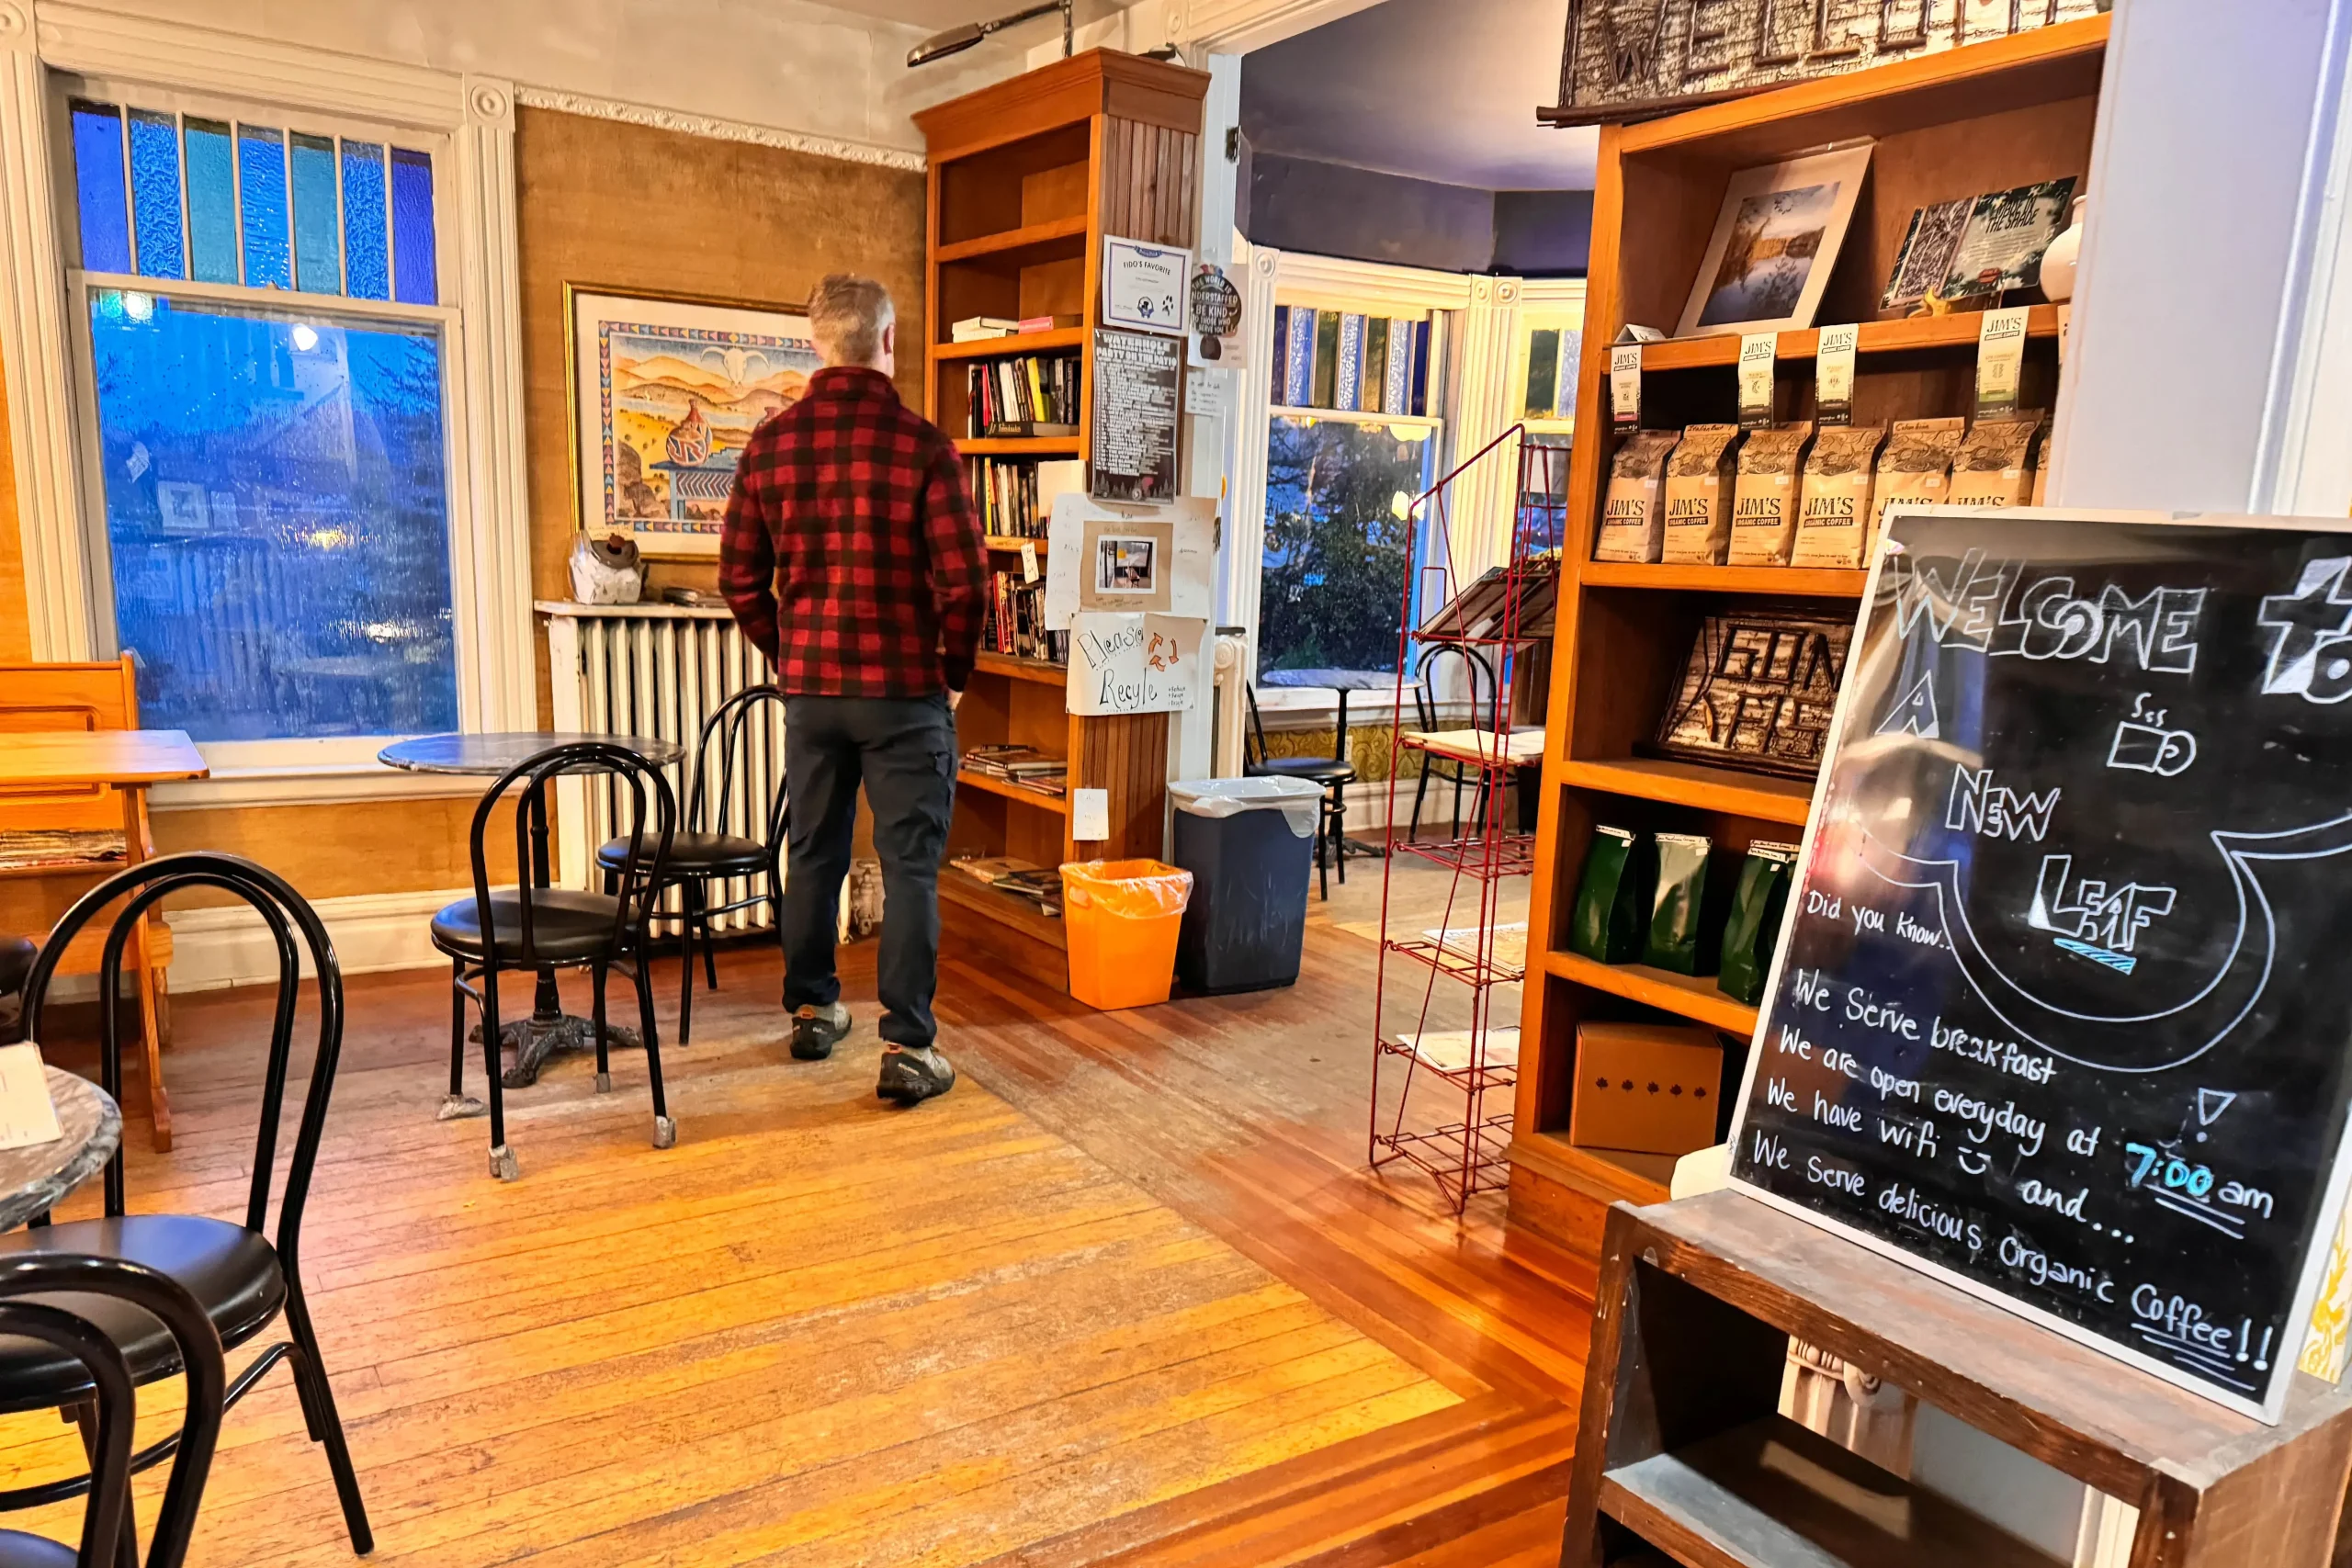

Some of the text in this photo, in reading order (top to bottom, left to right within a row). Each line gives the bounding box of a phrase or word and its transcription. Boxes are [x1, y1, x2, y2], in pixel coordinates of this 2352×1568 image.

[1985, 208, 2040, 233] THE SHADE
[1144, 262, 1170, 276] FAVORITE
[1191, 276, 1232, 294] THE WORLD IS
[1191, 291, 1238, 304] NDERSTAFFED
[1195, 304, 1227, 318] BE KIND
[1986, 317, 2022, 333] JIM'S
[1102, 333, 1170, 352] WATERHOLE
[1746, 341, 1771, 355] JIM'S
[1823, 332, 1852, 346] JIM'S
[1096, 347, 1177, 367] PARTY ON THE PATIO
[1614, 353, 1637, 365] JIM'S
[1607, 499, 1645, 515] JIM'S
[1669, 498, 1708, 515] JIM'S
[1736, 497, 1781, 515] JIM'S
[1804, 497, 1854, 516] JIM'S
[1805, 519, 1826, 527] ORGANIC
[1894, 547, 2206, 672] WELCOME
[1077, 626, 1144, 670] Please
[1100, 667, 1157, 710] Recyle
[1875, 670, 1939, 739] A
[1807, 889, 1841, 919] Did
[1851, 904, 1884, 936] you
[1795, 968, 1831, 1011] We
[1930, 1016, 2058, 1085] breakfast
[1768, 1077, 1798, 1112] We
[1814, 1090, 1862, 1132] have
[1779, 1024, 2274, 1219] We are open everyday at 7:00 am
[1754, 1130, 1790, 1169] We
[1879, 1182, 1983, 1250] delicious
